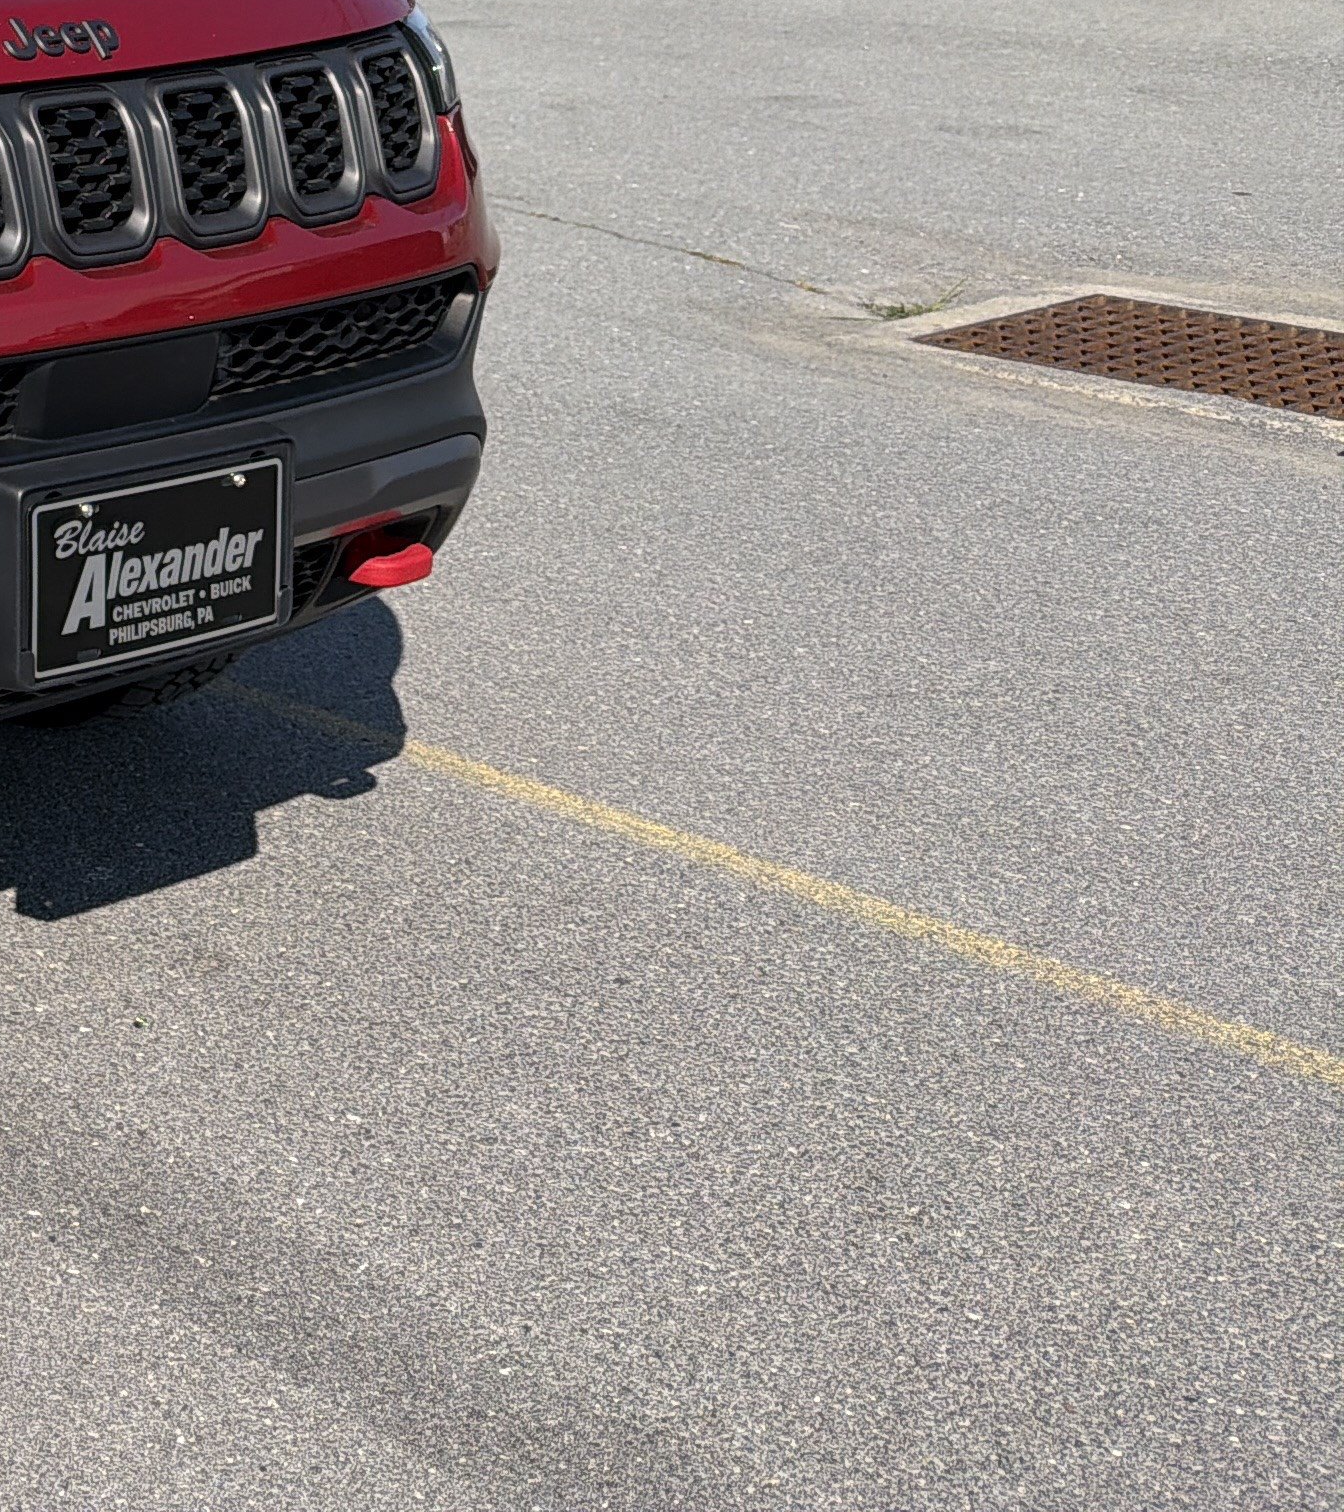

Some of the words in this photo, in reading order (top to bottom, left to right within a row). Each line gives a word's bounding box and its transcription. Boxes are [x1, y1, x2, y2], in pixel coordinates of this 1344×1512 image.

[2, 17, 120, 61] Jeep
[52, 518, 146, 560] Blaise
[60, 526, 265, 636] Alexander
[112, 588, 196, 623] CHEVROLET
[210, 574, 253, 600] BUICK
[108, 614, 195, 646] PHILIPSBURG,
[197, 605, 215, 625] PA
